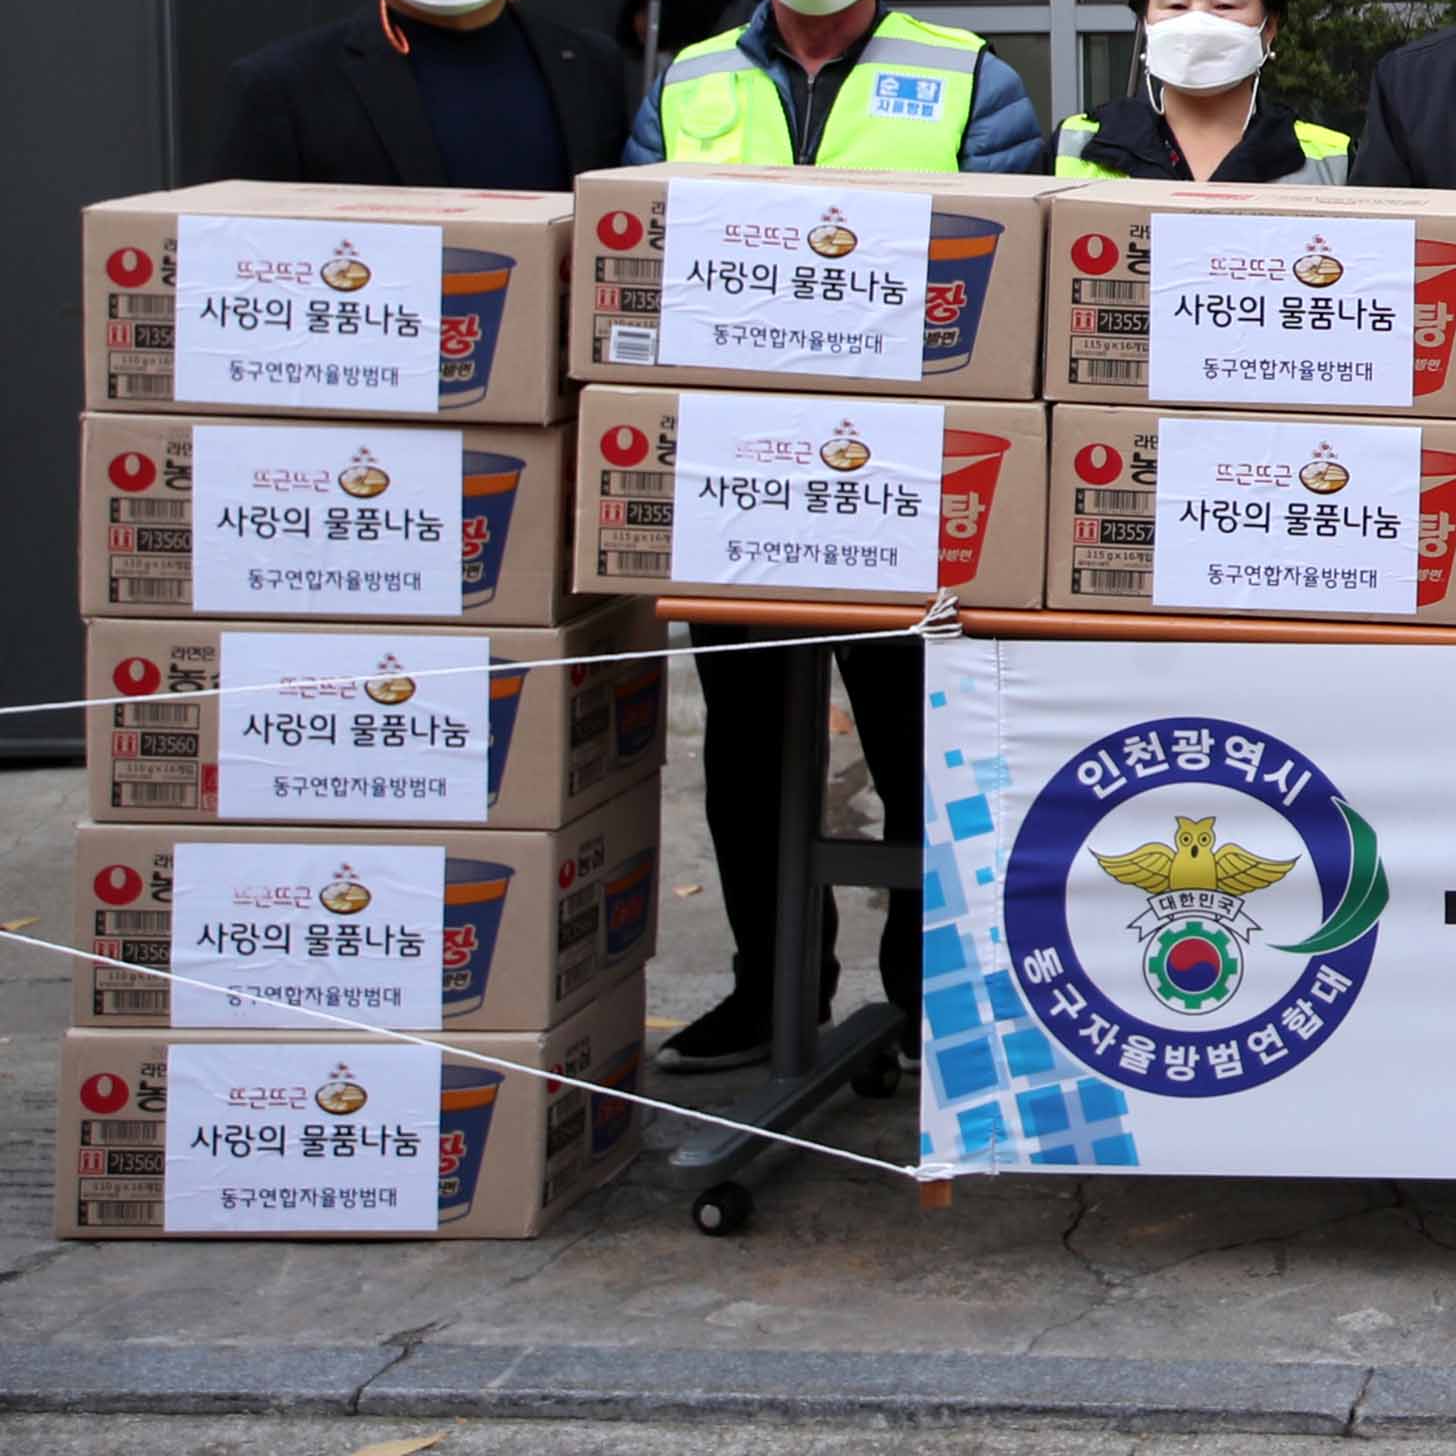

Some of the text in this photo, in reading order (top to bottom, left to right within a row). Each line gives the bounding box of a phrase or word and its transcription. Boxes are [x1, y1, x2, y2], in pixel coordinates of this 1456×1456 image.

[686, 259, 908, 306] 사랑의 물품나눔
[200, 296, 292, 331] 사랑의
[306, 300, 421, 338] 물품나눔
[1173, 293, 1397, 332] 사랑의 물품나눔
[713, 323, 883, 355] 동구연합자율방범대
[229, 360, 399, 387] 동구연합자율방범대
[1202, 357, 1373, 383] 동구연합자율방범대
[698, 476, 922, 518] 사랑의 물품나눔
[217, 506, 310, 540] 사랑의
[324, 507, 444, 542] 물품나눔
[1179, 499, 1271, 534] 사랑의
[1283, 502, 1402, 540] 물품나눔
[727, 539, 898, 568] 동구연합자율방범대
[248, 568, 421, 593] 동구연합자율방범대
[1207, 563, 1378, 590] 동구연합자율방범대
[243, 713, 470, 748] 사랑의 물품나눔
[1077, 728, 1313, 807] 인천광역시
[273, 776, 447, 799] 동구연합자율방범대
[1158, 889, 1237, 914] 대한민국
[196, 922, 291, 957] 사랑의
[304, 923, 425, 958] 물품나눔
[1022, 946, 1353, 1083] 동구자율방범연합대
[190, 1124, 286, 1159] 사랑의
[299, 1124, 421, 1158] 물품나눔
[220, 1187, 397, 1210] 동구연합자율방범대
